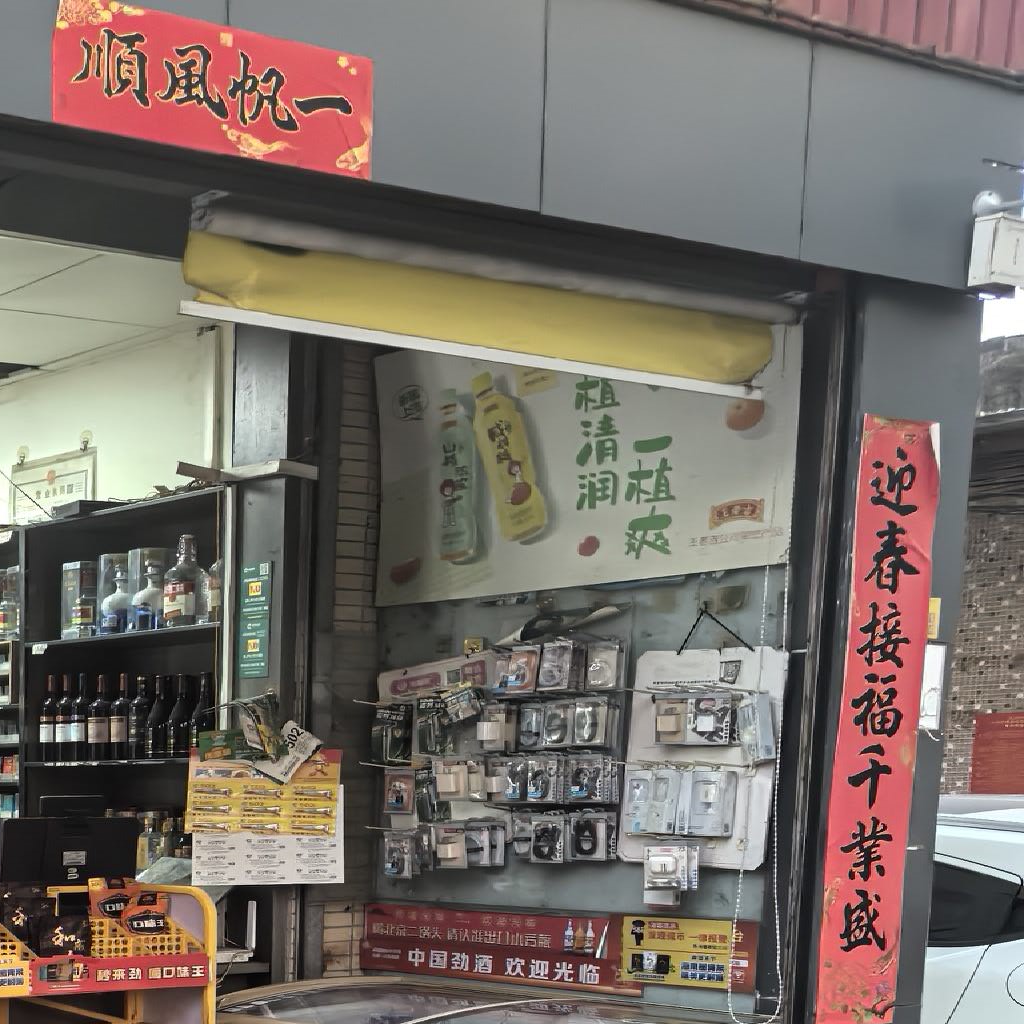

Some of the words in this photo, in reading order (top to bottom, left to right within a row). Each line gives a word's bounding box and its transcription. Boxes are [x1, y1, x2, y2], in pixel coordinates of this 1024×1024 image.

[408, 948, 494, 974] 中国劲酒
[504, 957, 601, 985] 欢迎光临
